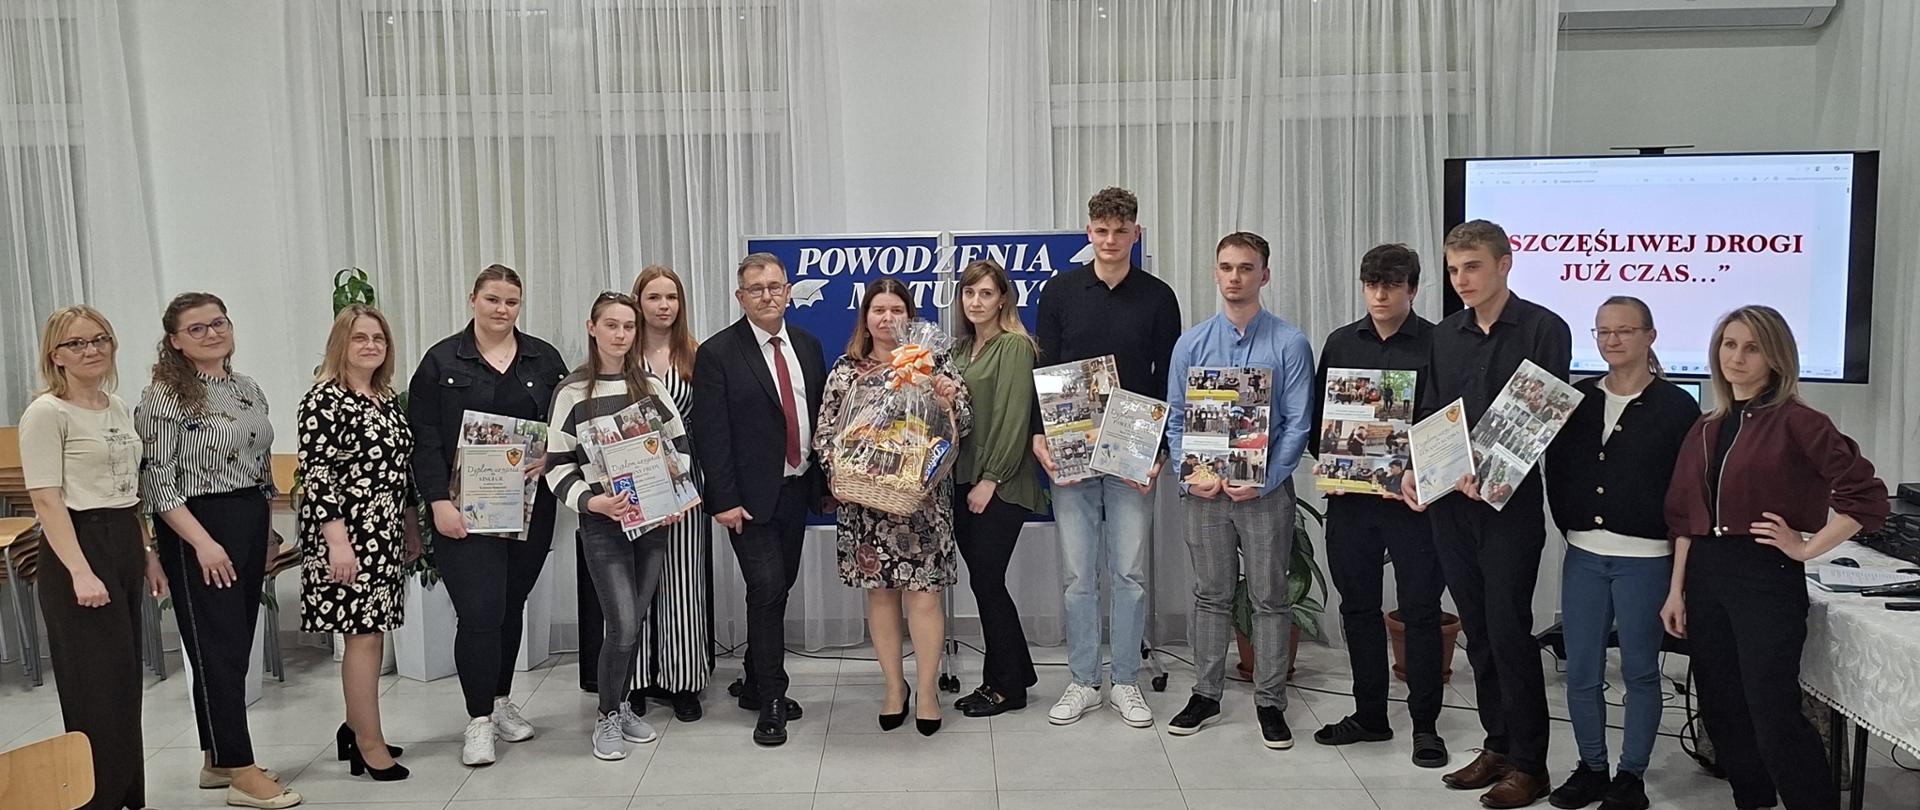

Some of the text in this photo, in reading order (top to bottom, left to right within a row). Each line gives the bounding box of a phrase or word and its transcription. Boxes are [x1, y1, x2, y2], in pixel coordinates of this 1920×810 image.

[1508, 228, 1804, 257] SZCZĘŚLIWEJ DROGI
[796, 243, 1054, 277] POWODZENIA
[1560, 258, 1612, 282] JUŻ
